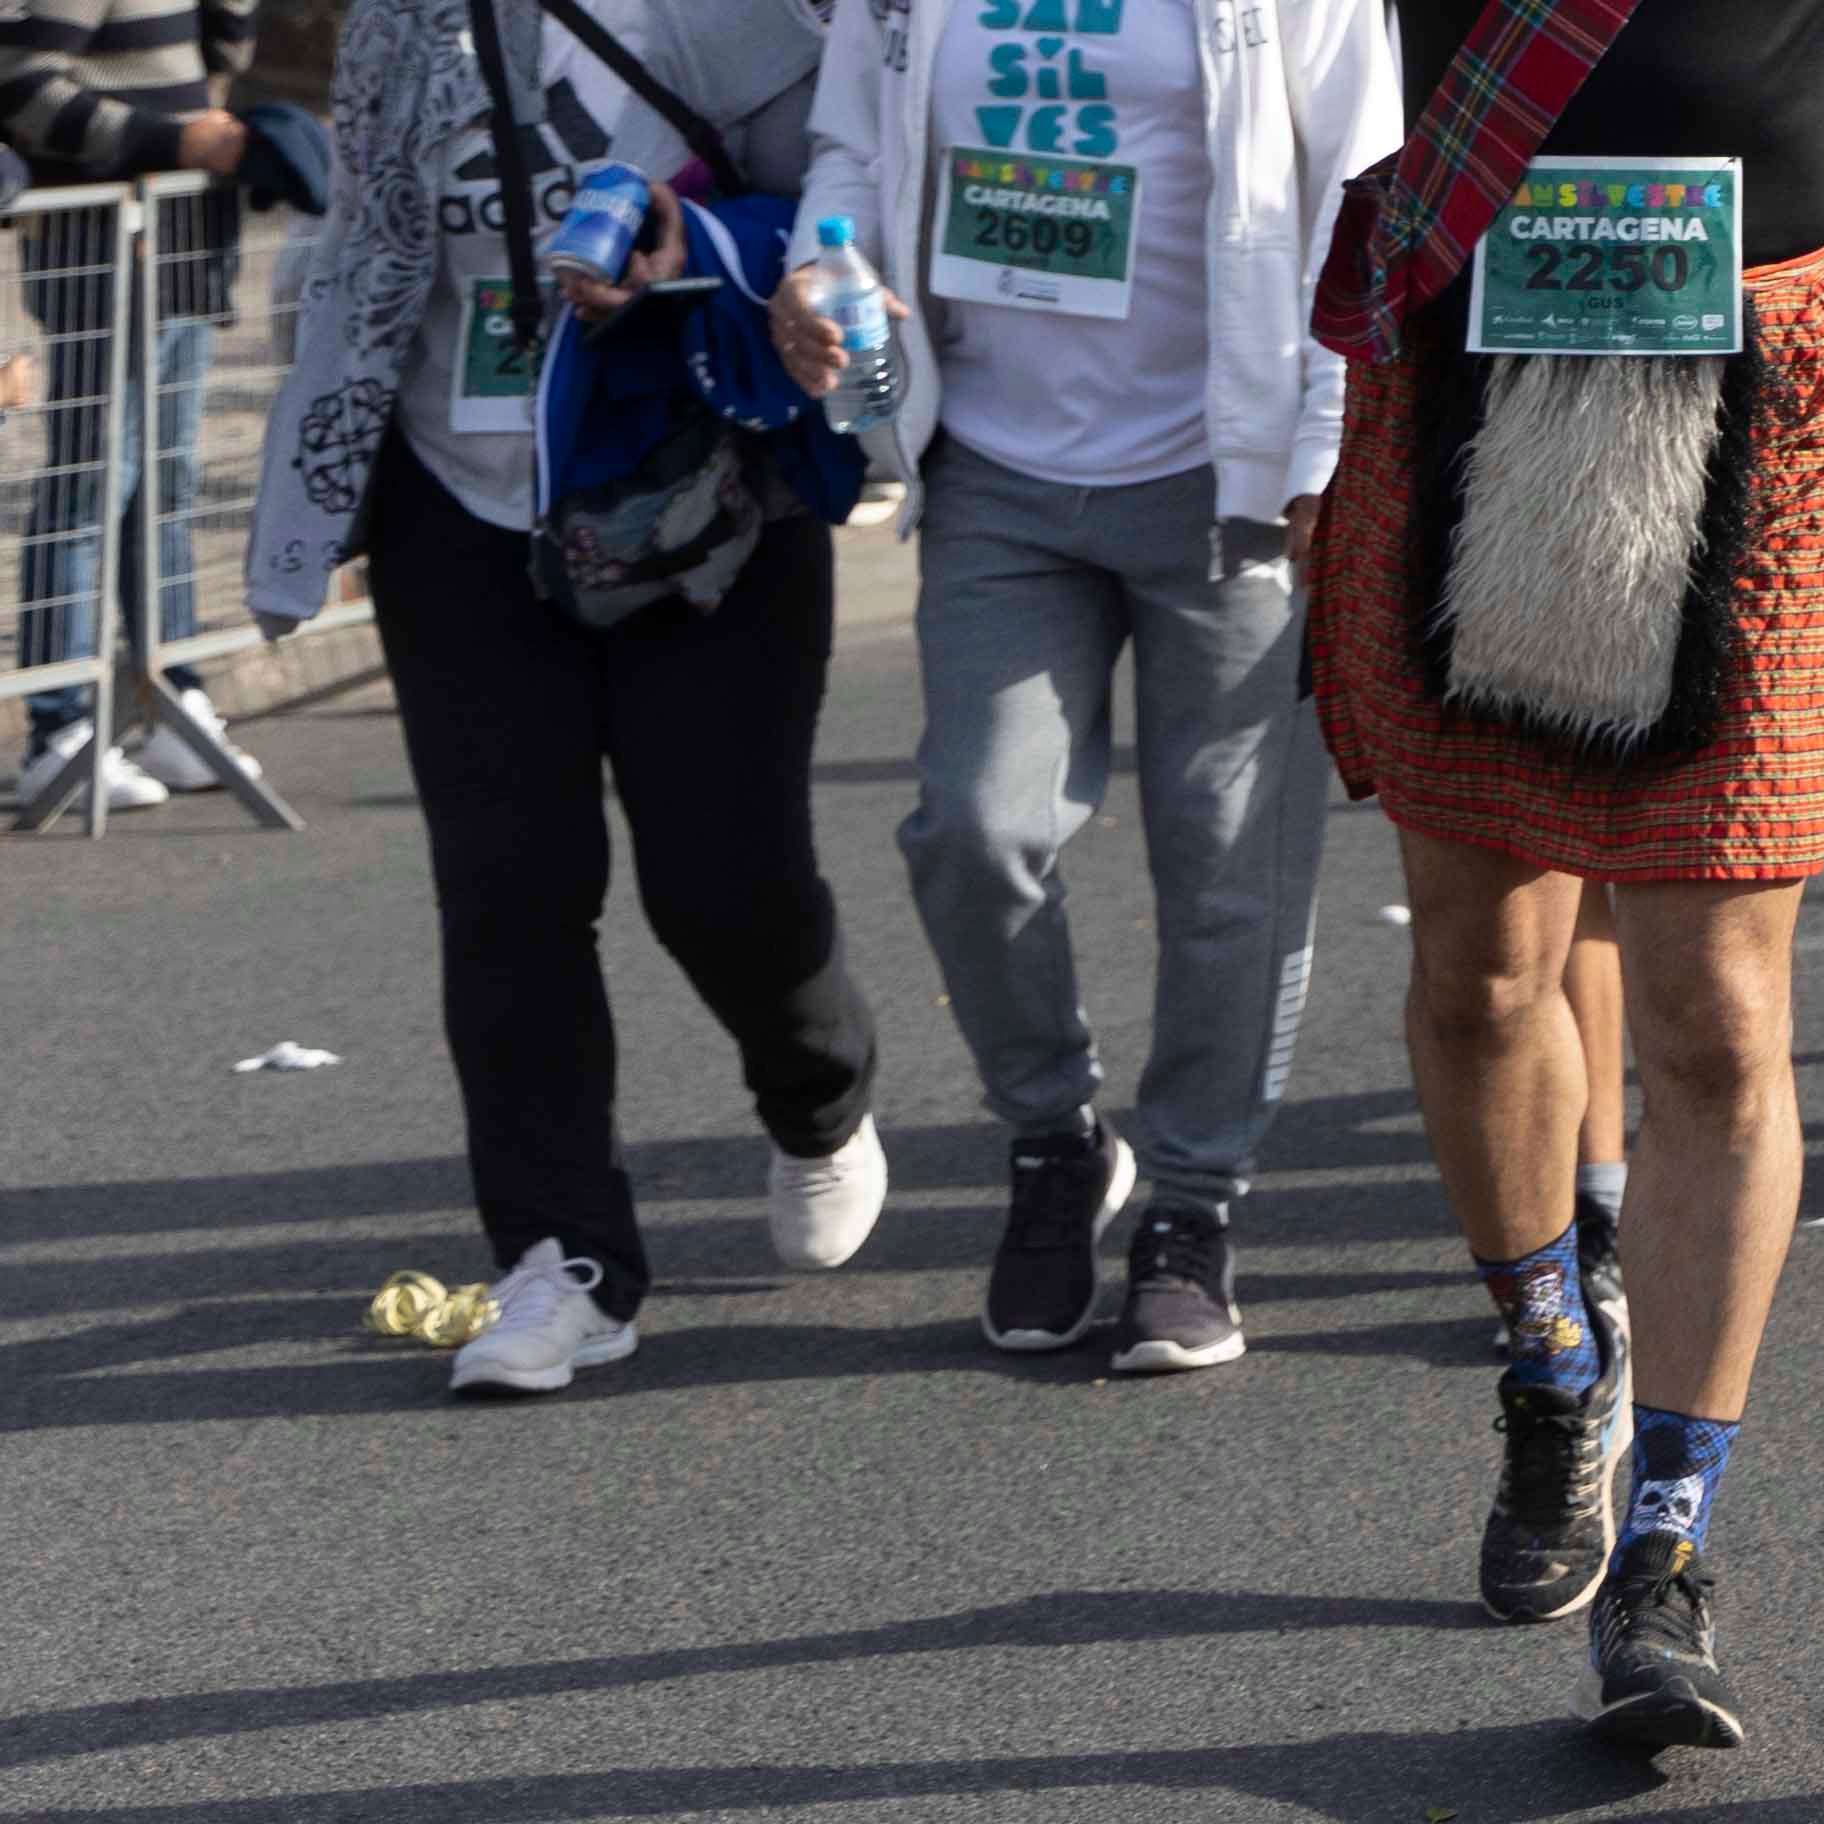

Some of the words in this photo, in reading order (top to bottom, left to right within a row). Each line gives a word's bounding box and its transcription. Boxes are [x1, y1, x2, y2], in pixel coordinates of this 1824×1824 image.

[964, 185, 1111, 221] CARTAGENA
[975, 209, 1093, 259] 2609
[1510, 215, 1709, 242] CARTAGENA
[1523, 242, 1690, 293] 2250
